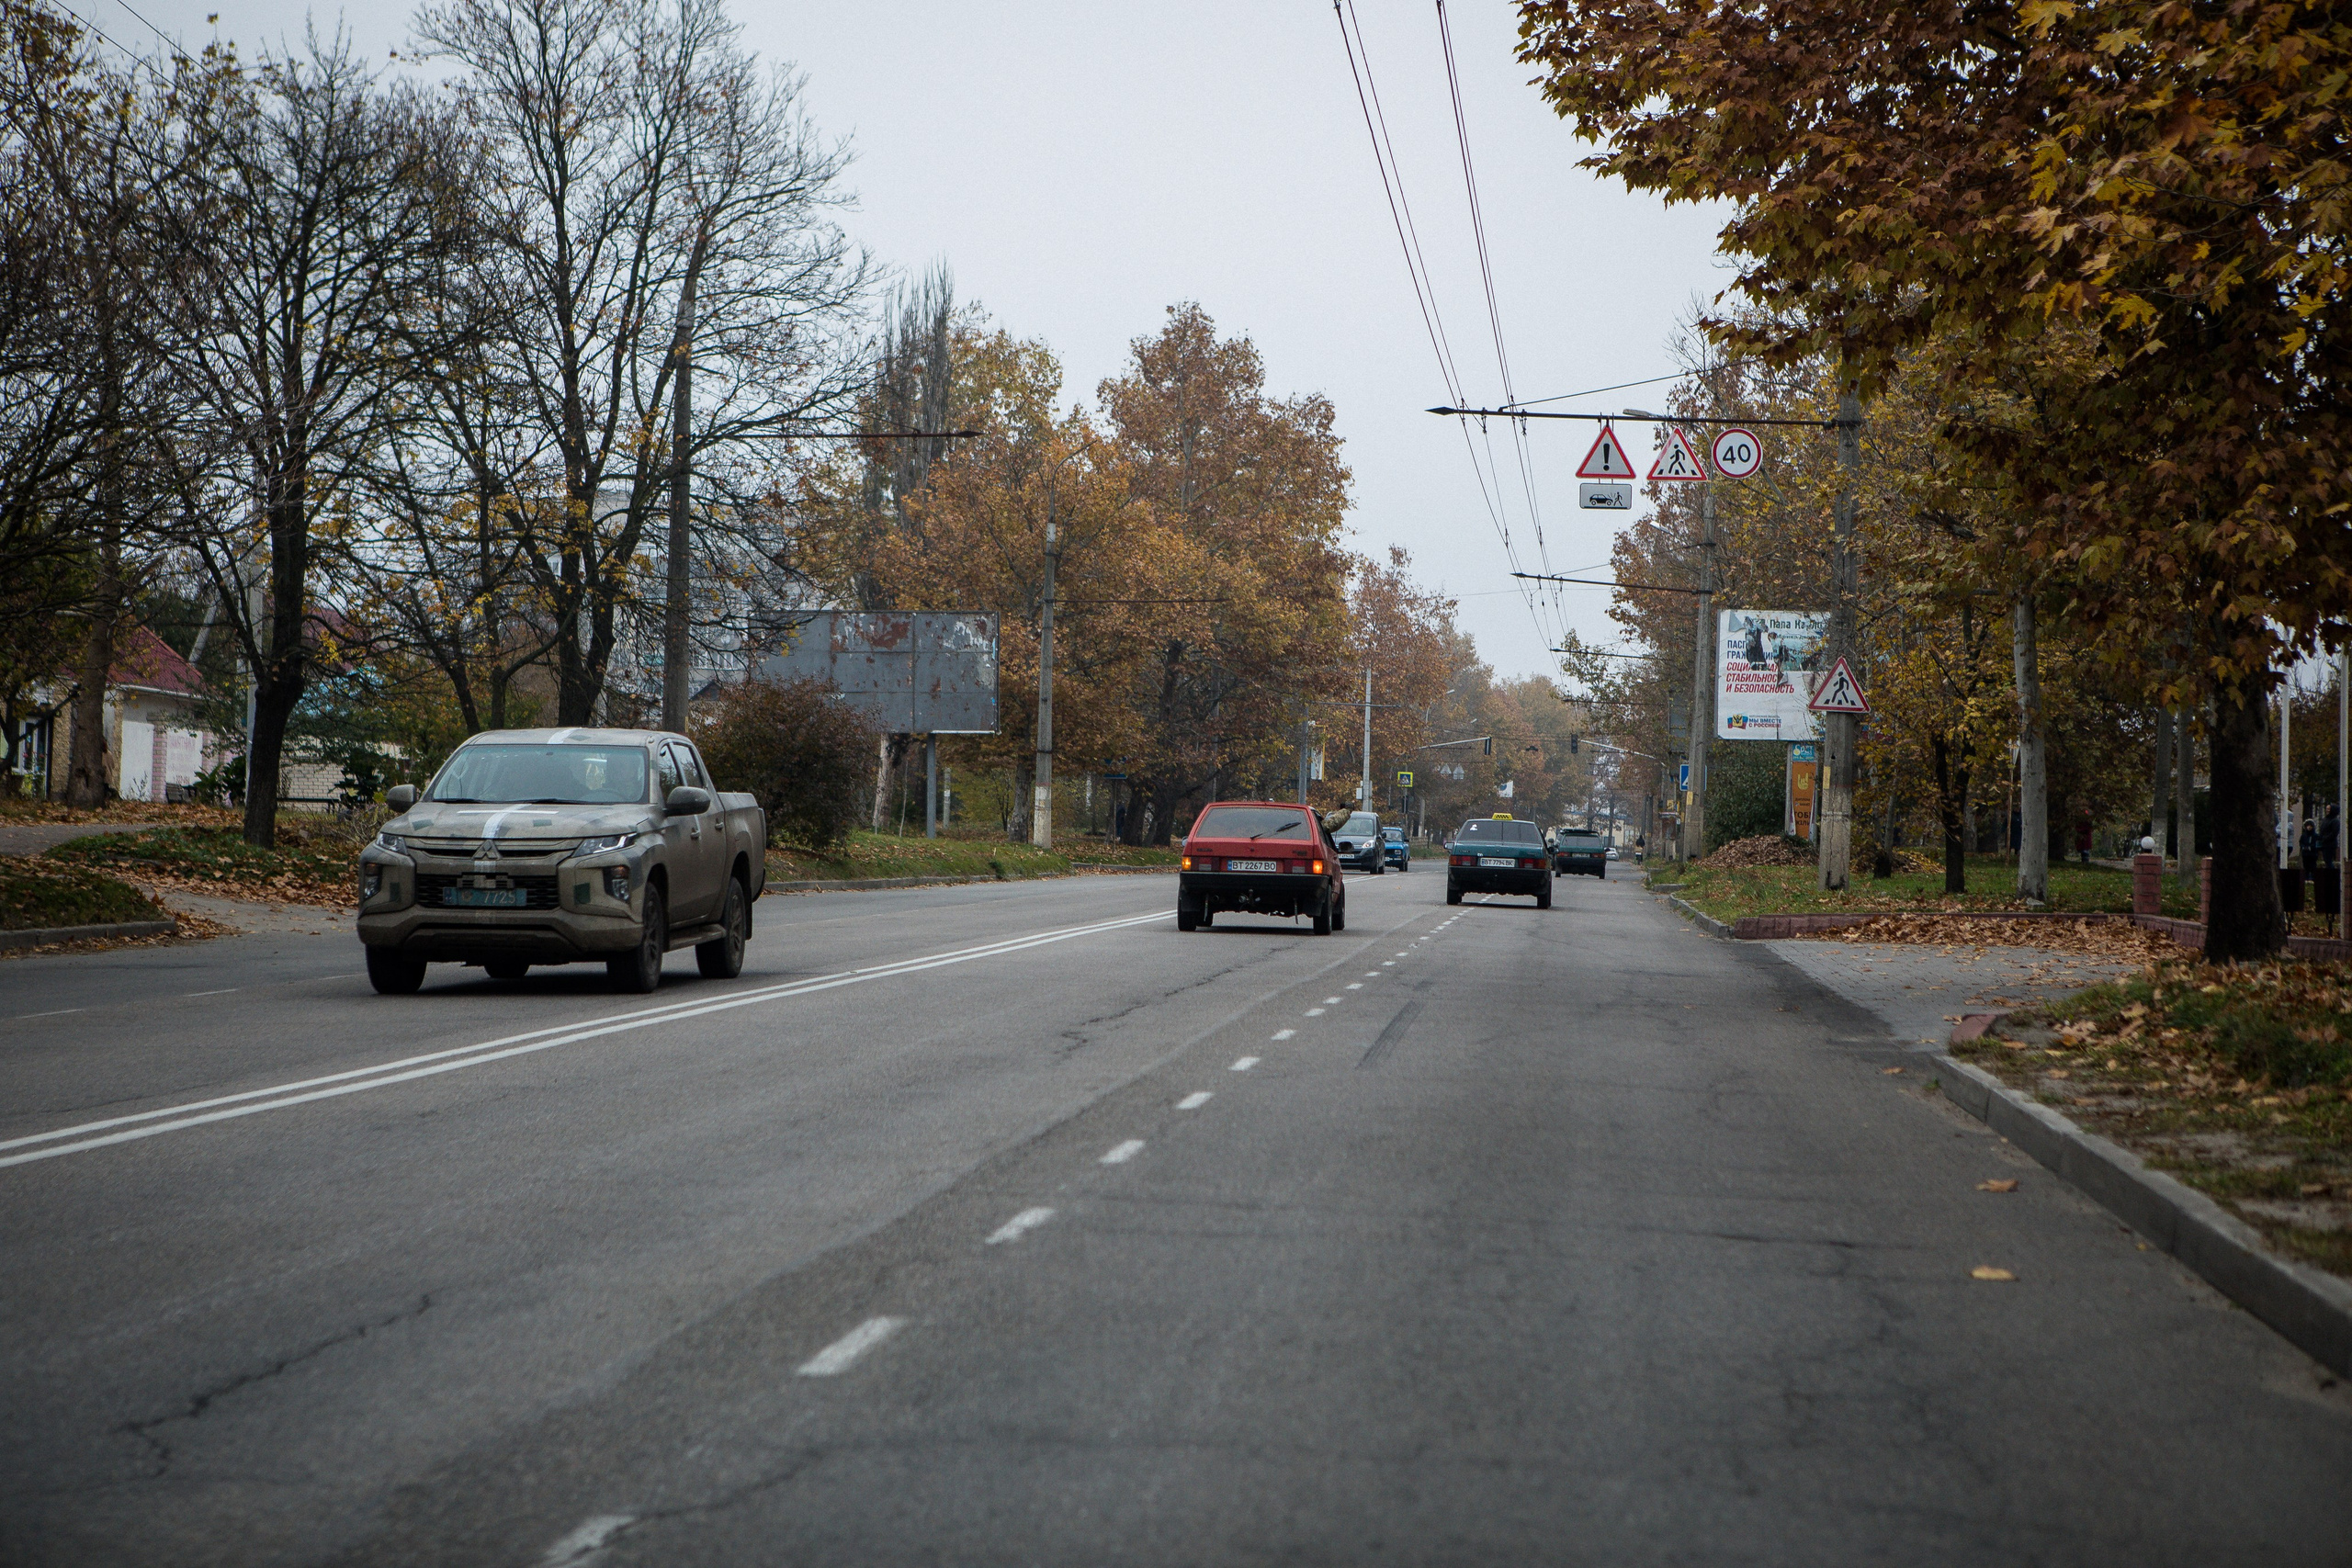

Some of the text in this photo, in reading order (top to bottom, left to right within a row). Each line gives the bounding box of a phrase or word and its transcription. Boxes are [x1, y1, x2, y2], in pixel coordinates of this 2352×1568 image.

[1723, 444, 1751, 464] 40
[1725, 683, 1794, 694] И БЕЗОПАСНОСТЬ
[1232, 861, 1276, 871] BT 2267 BO
